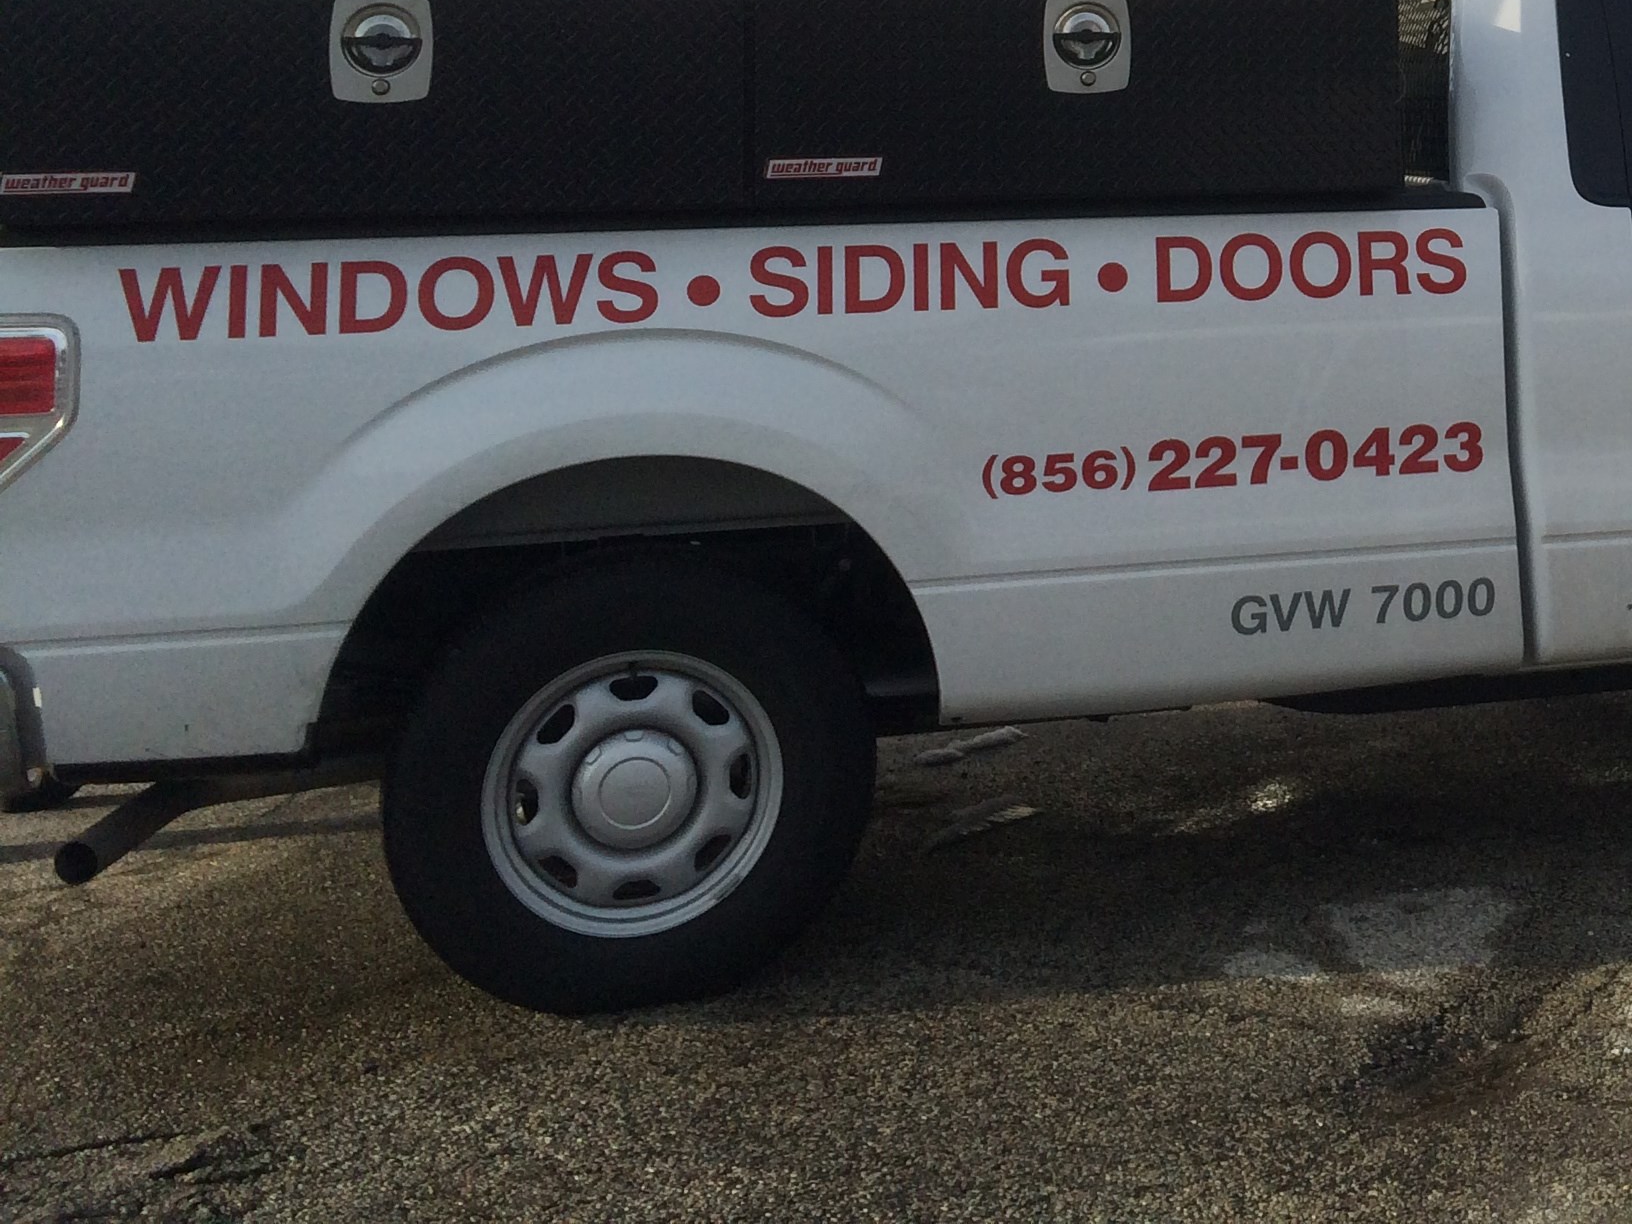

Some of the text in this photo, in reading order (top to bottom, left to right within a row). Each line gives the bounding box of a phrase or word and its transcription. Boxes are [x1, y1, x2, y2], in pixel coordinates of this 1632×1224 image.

[4, 174, 130, 191] weather guard
[771, 158, 878, 175] weather guard
[118, 228, 1467, 342] WINDOWS SIDING DOORS
[981, 421, 1484, 499] (856) 227-0423
[1231, 577, 1496, 636] GVW 7000
